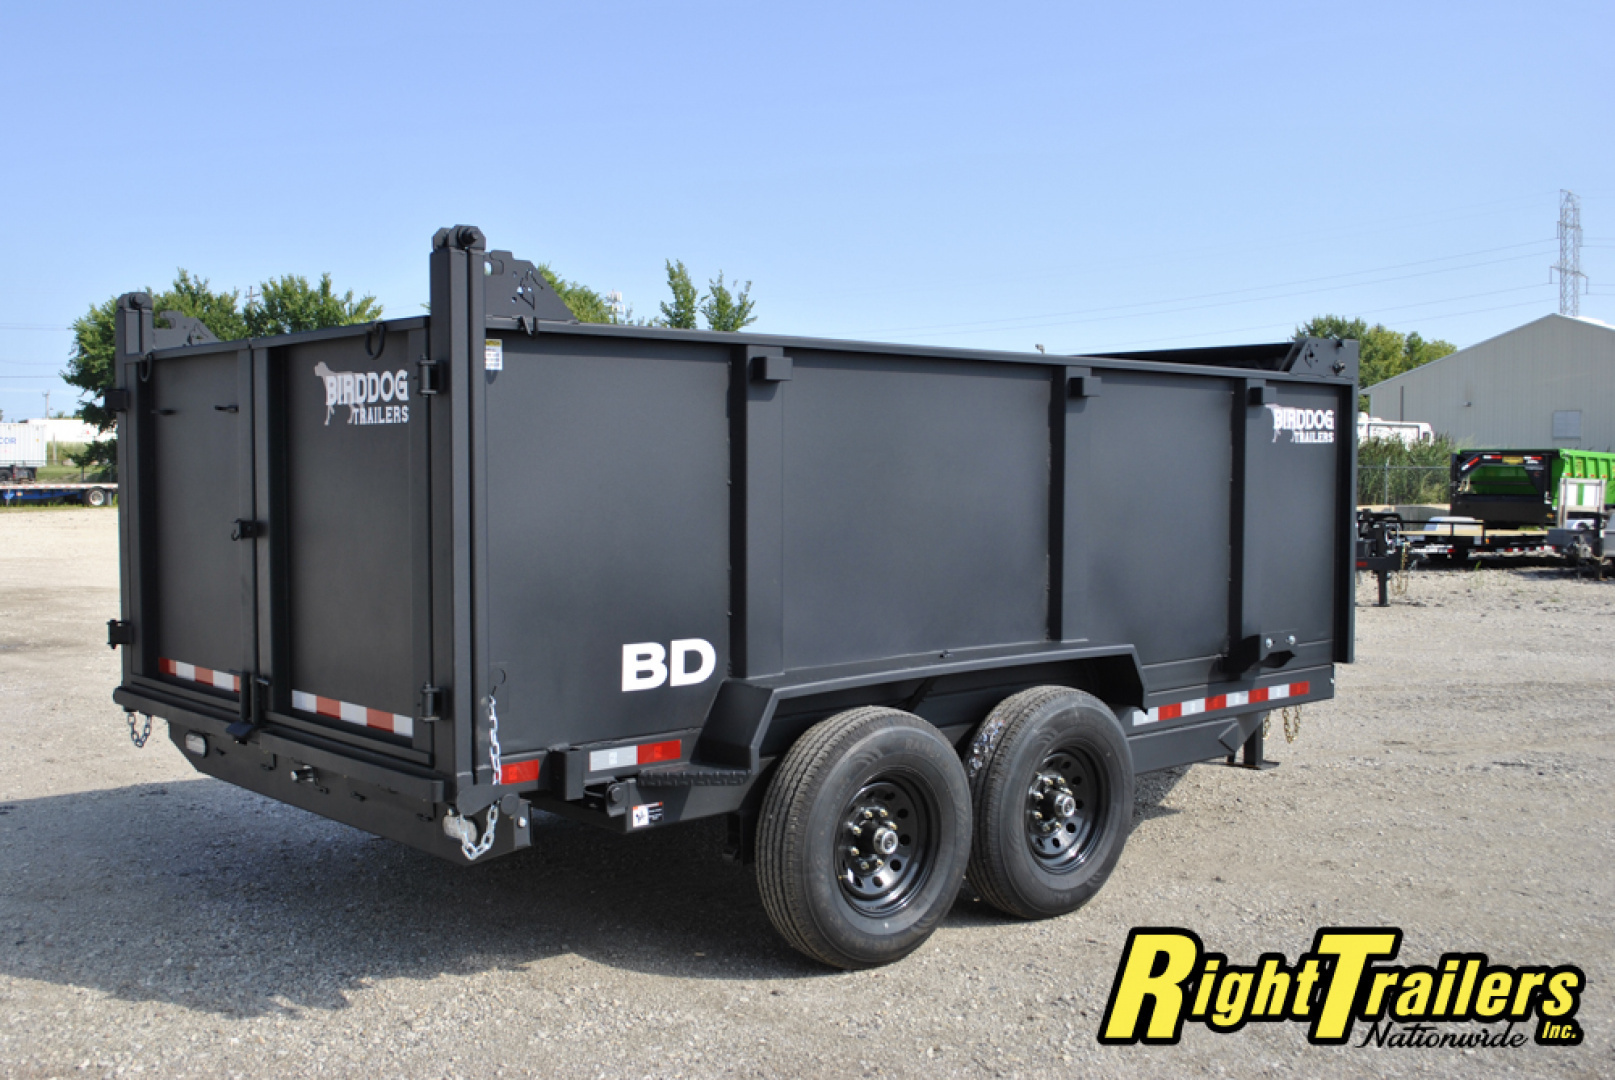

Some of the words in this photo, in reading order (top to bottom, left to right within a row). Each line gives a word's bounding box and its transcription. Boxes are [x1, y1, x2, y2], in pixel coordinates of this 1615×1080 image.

[326, 369, 409, 406] BIRDDOG
[353, 405, 410, 425] TRAILERS
[1273, 408, 1335, 430] BIRDDOG
[1294, 430, 1335, 444] TRAILERS
[621, 638, 717, 692] BD
